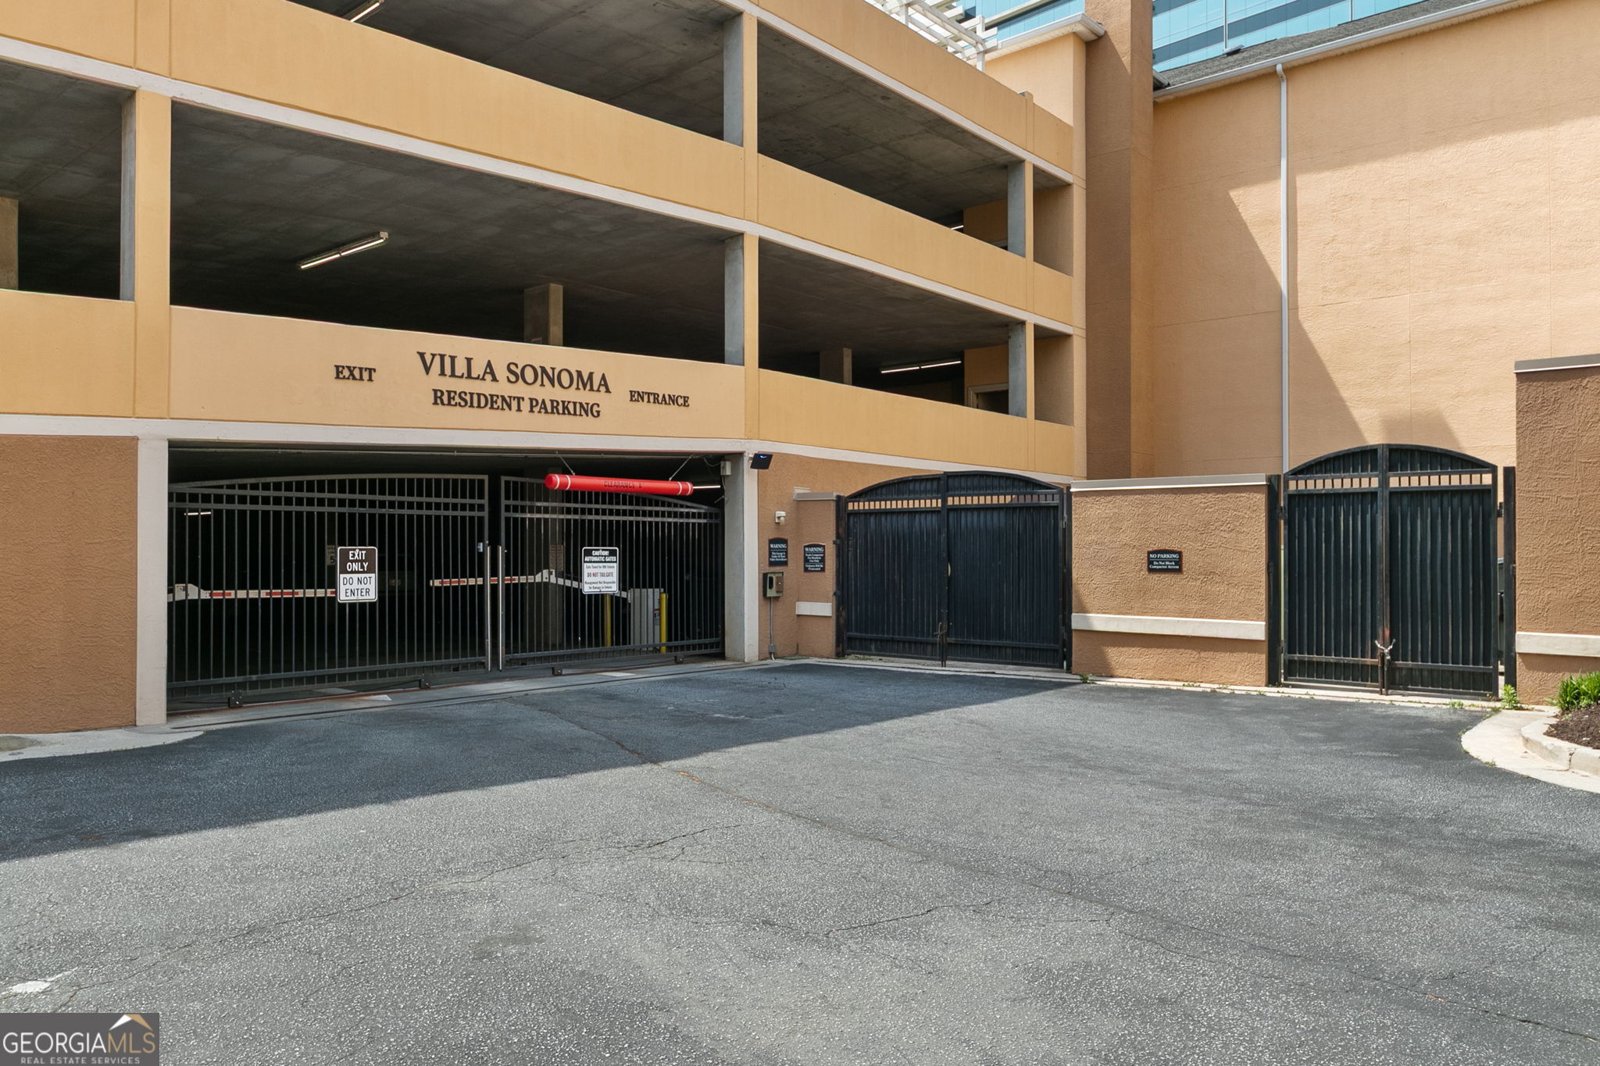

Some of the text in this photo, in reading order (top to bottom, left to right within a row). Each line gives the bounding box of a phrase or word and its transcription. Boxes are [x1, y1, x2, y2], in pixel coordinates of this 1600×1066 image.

[334, 364, 377, 382] EXIT
[416, 351, 612, 394] VILLA SONOMA
[432, 388, 601, 418] RESIDENT PARKING
[629, 390, 690, 408] ENTRANCE
[349, 550, 366, 560] EXIT
[346, 562, 369, 571] ONLY
[342, 576, 372, 586] DO NOT
[344, 588, 371, 597] ENTER
